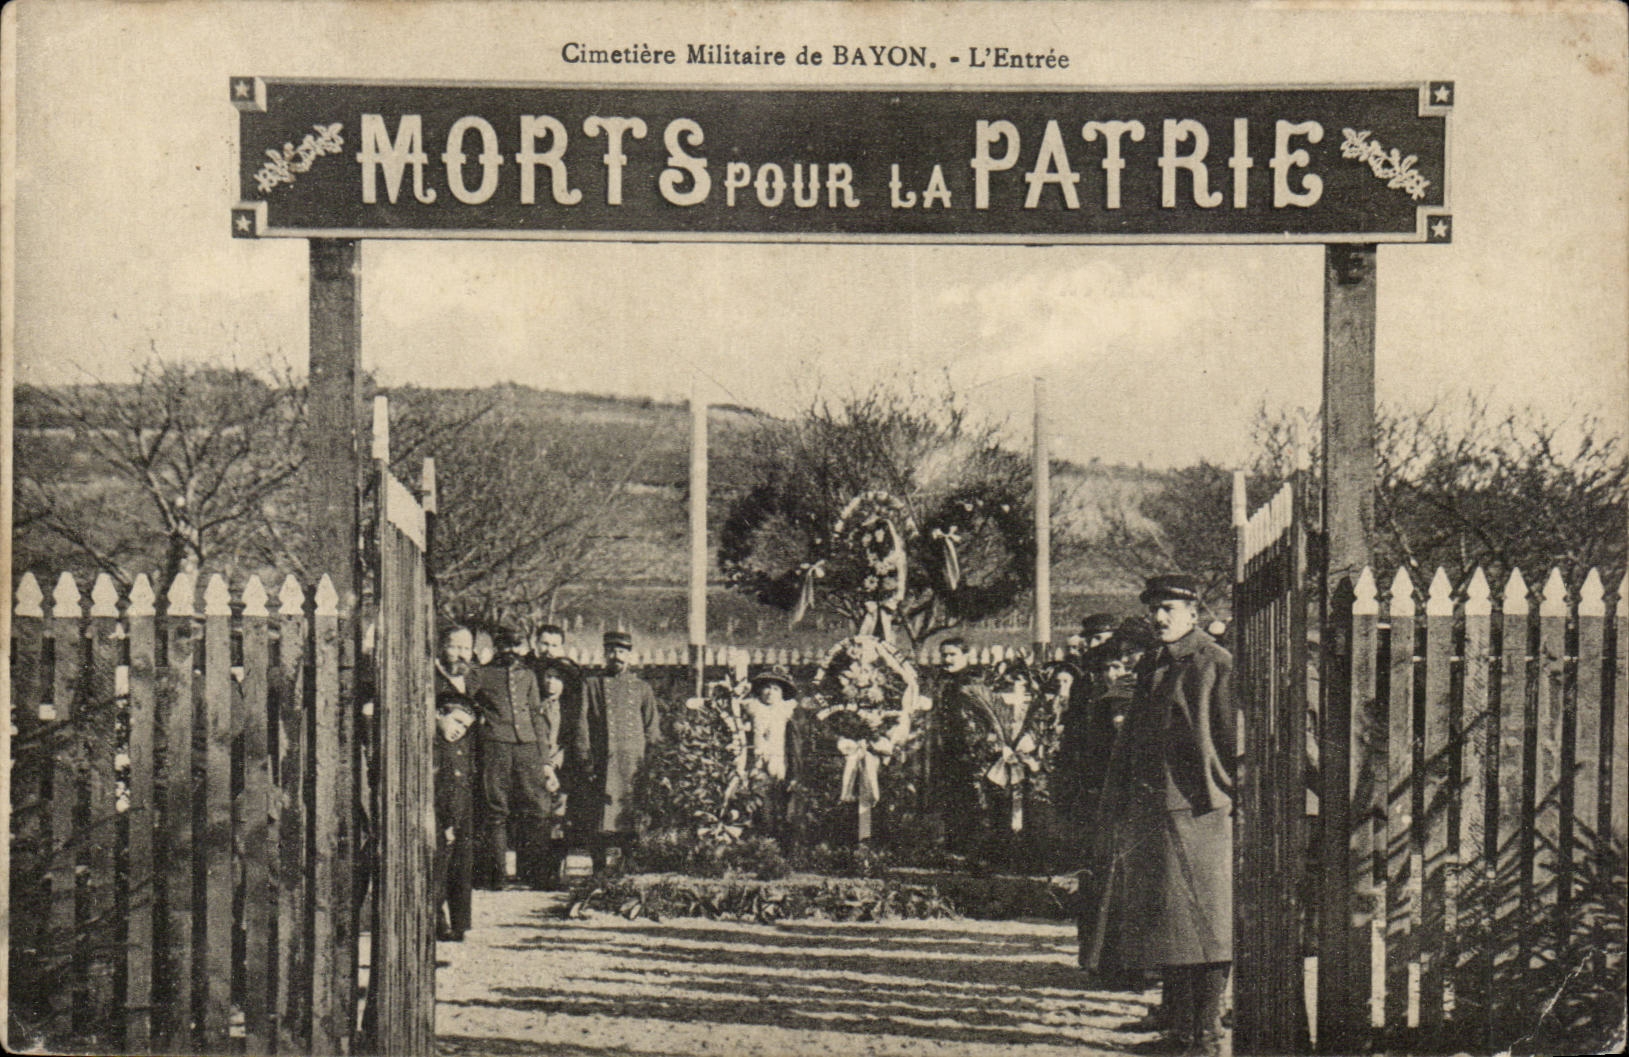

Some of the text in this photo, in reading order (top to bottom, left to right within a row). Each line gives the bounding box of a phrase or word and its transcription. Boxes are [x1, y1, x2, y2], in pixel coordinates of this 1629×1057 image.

[357, 114, 1323, 208] MORTS POUR LA PATRIE
